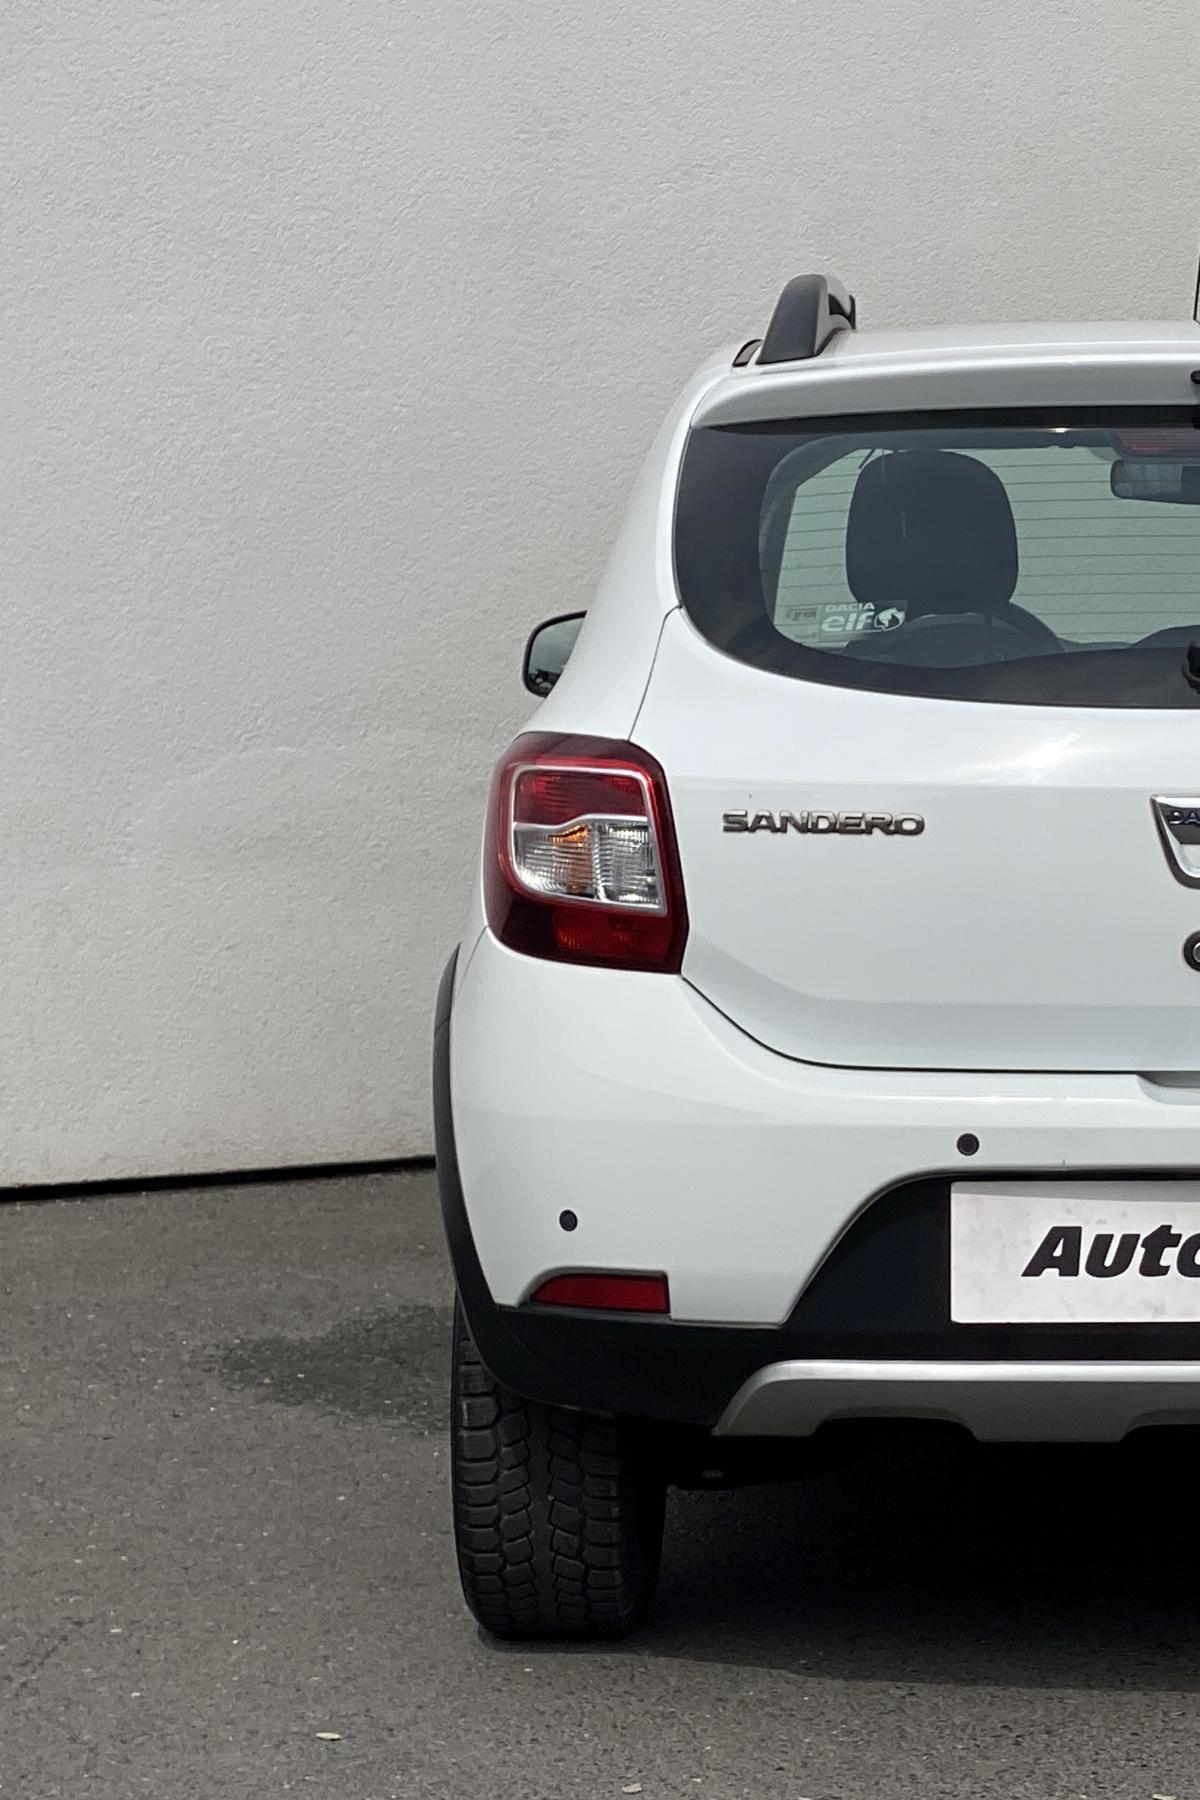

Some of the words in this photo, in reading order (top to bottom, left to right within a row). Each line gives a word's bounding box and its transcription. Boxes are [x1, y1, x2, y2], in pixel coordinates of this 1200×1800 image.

[825, 602, 875, 613] DACIA
[821, 611, 875, 632] elf
[722, 808, 926, 836] SANDERO
